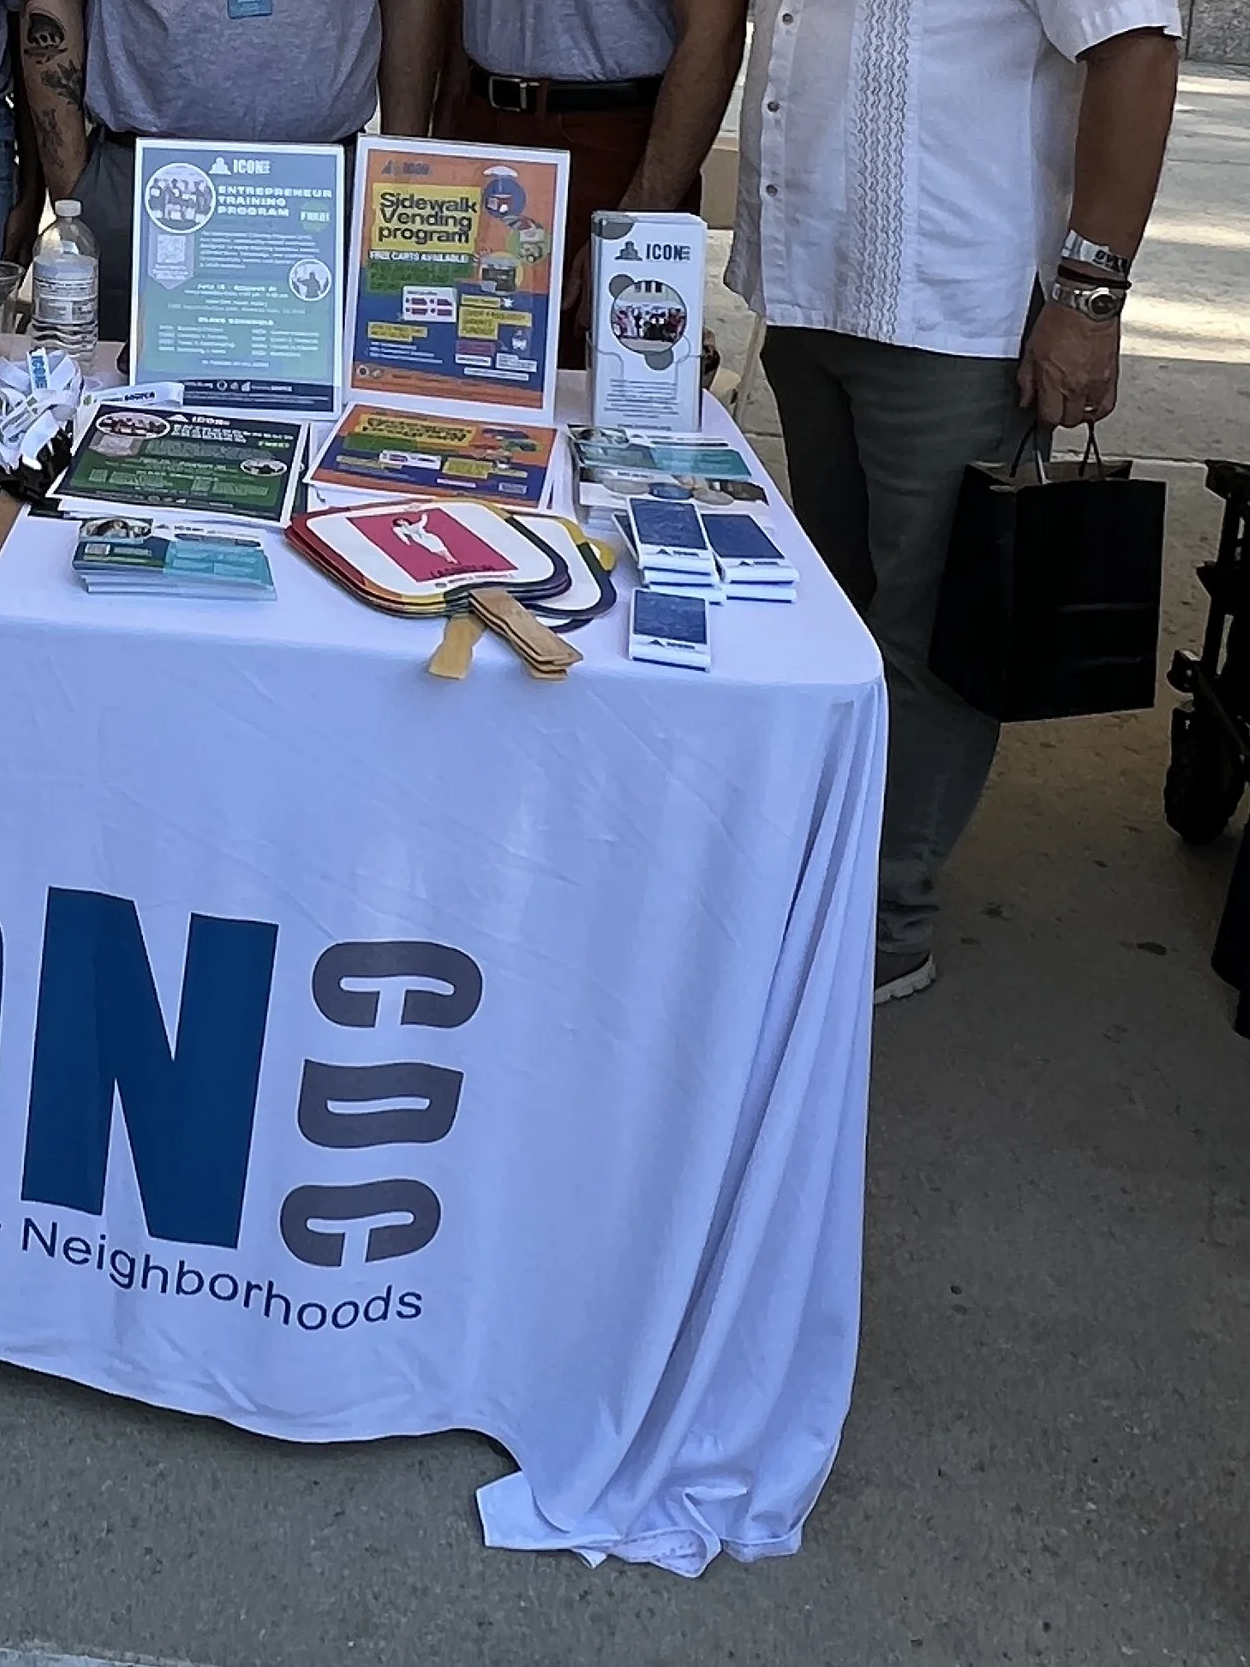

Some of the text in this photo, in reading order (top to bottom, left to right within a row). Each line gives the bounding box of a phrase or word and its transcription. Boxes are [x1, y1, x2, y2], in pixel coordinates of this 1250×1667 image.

[218, 185, 332, 199] ENTREPRENEUR
[218, 196, 287, 207] TRAINING
[380, 192, 478, 213] Sidewalk
[217, 206, 290, 218] PROGRAM
[380, 208, 473, 232] Vending
[378, 225, 470, 246] program
[646, 244, 682, 260] ICON
[280, 941, 482, 1267] CDC
[22, 1218, 422, 1330] Neighborhoods
